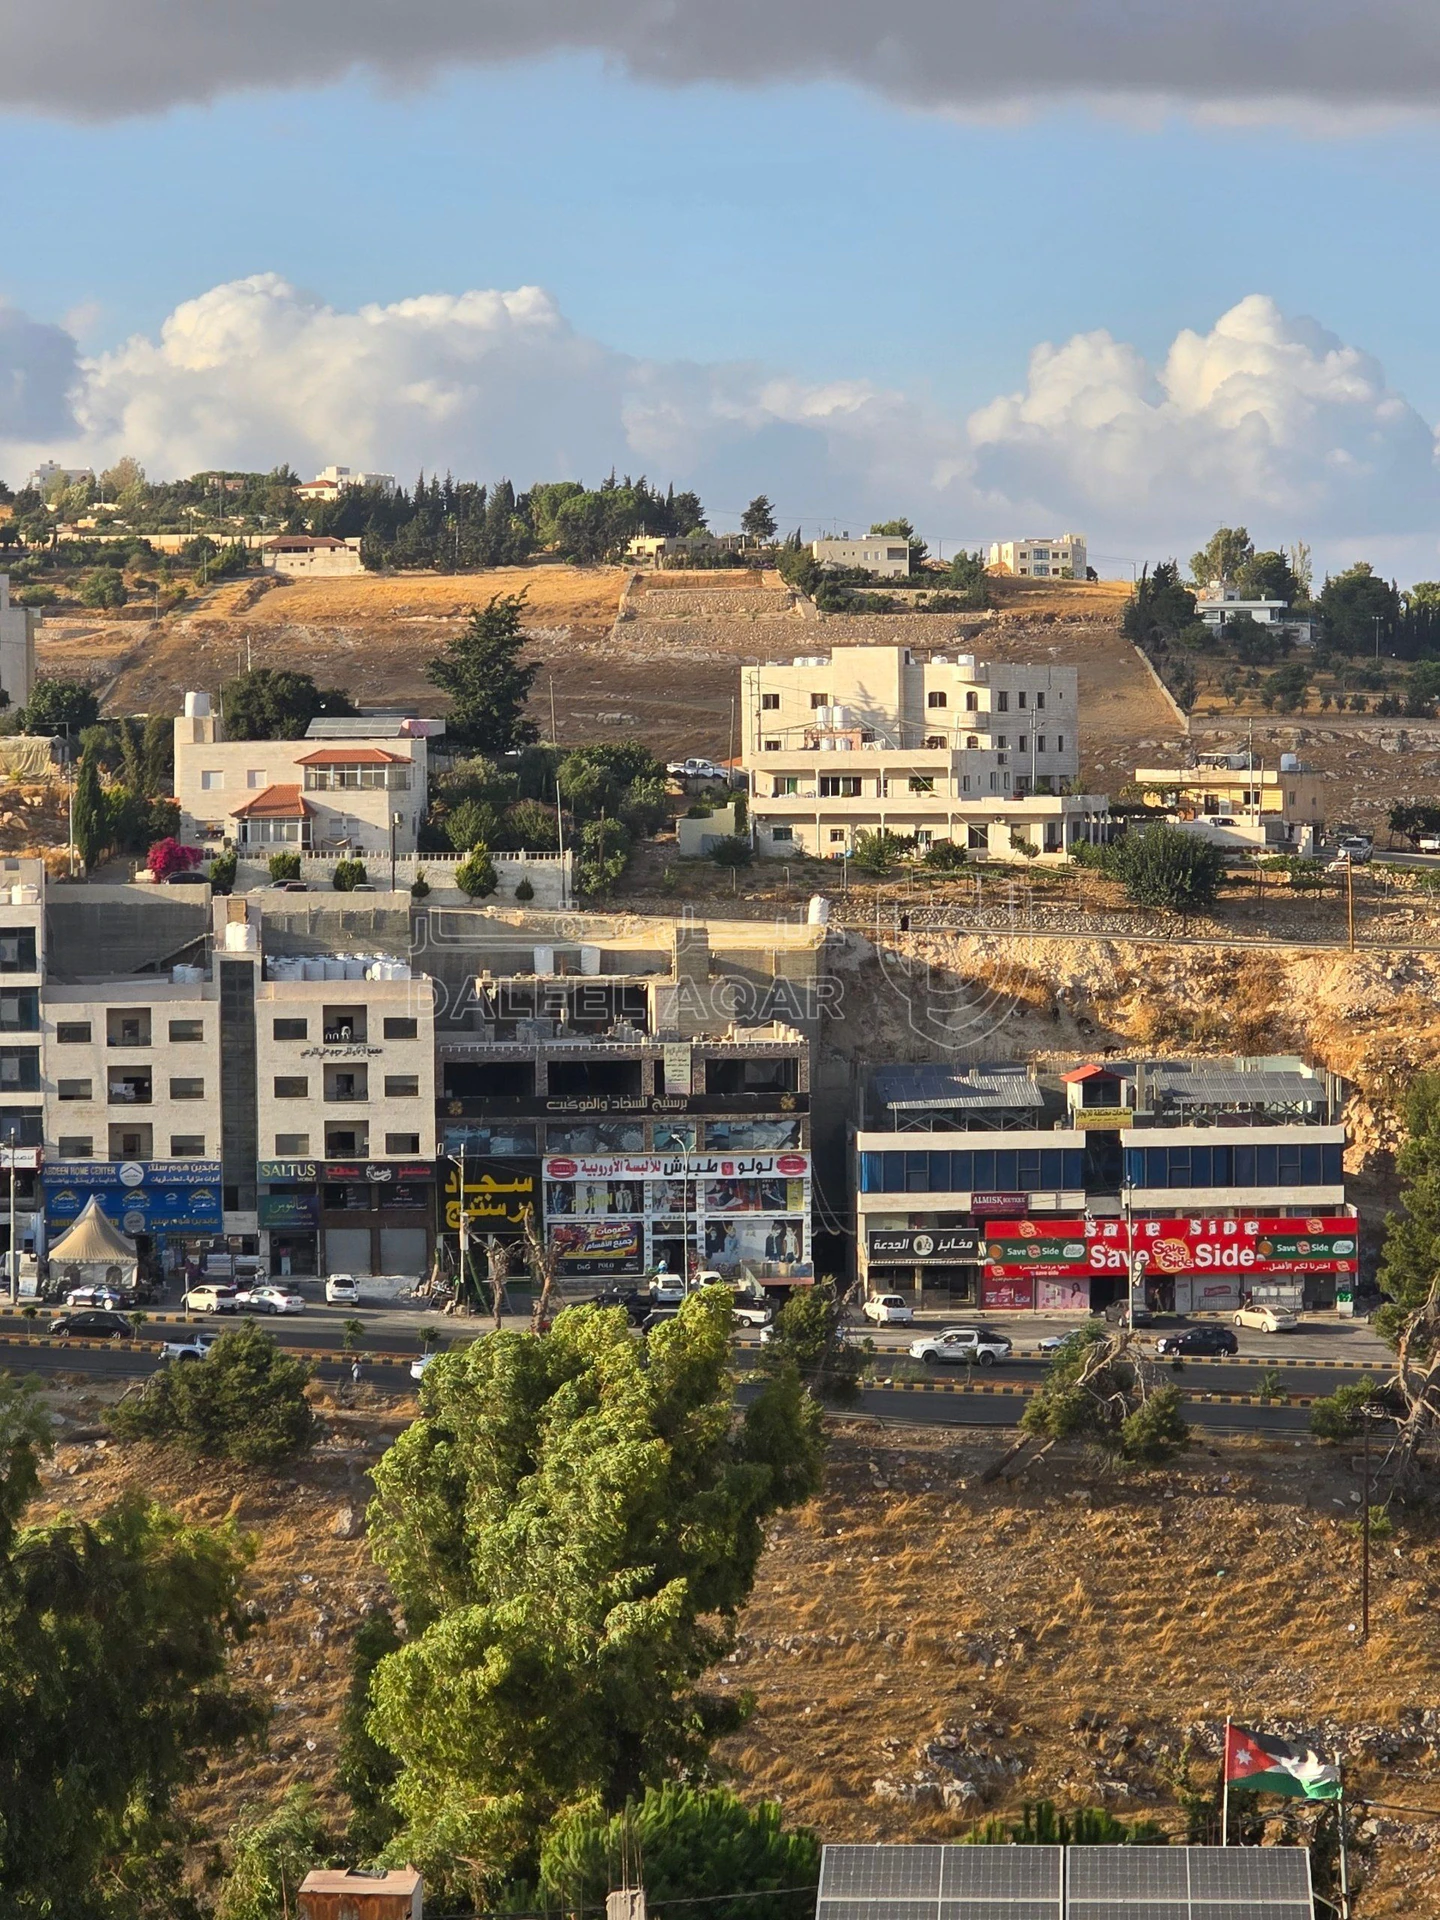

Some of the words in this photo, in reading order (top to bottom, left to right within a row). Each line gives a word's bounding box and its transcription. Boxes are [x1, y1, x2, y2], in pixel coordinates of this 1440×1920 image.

[612, 1096, 648, 1111] للسجاد
[652, 1097, 688, 1112] برستيج
[70, 1166, 88, 1176] HOME
[90, 1166, 116, 1175] CENTER
[147, 1163, 167, 1173] سنتر
[169, 1164, 189, 1173] هوم
[191, 1164, 220, 1173] عابدين
[261, 1164, 316, 1177] SALTUS
[580, 1157, 622, 1176] الأوروبية
[624, 1156, 661, 1175] للألبسة
[737, 1157, 773, 1175] لولو
[445, 1168, 533, 1201] سجد
[973, 1196, 1003, 1205] ALMISK
[873, 1239, 909, 1250] الجدعة
[938, 1239, 973, 1251] مخابز
[1152, 1239, 1187, 1256] Save
[1277, 1244, 1296, 1252] Save
[1311, 1243, 1329, 1252] Side
[1007, 1247, 1027, 1256] Save
[1042, 1247, 1059, 1255] Side
[1089, 1244, 1149, 1268] Save
[1195, 1243, 1255, 1268] Side
[1162, 1254, 1194, 1269] Side
[1294, 1262, 1308, 1272] لكم
[1309, 1262, 1331, 1271] اخترنا
